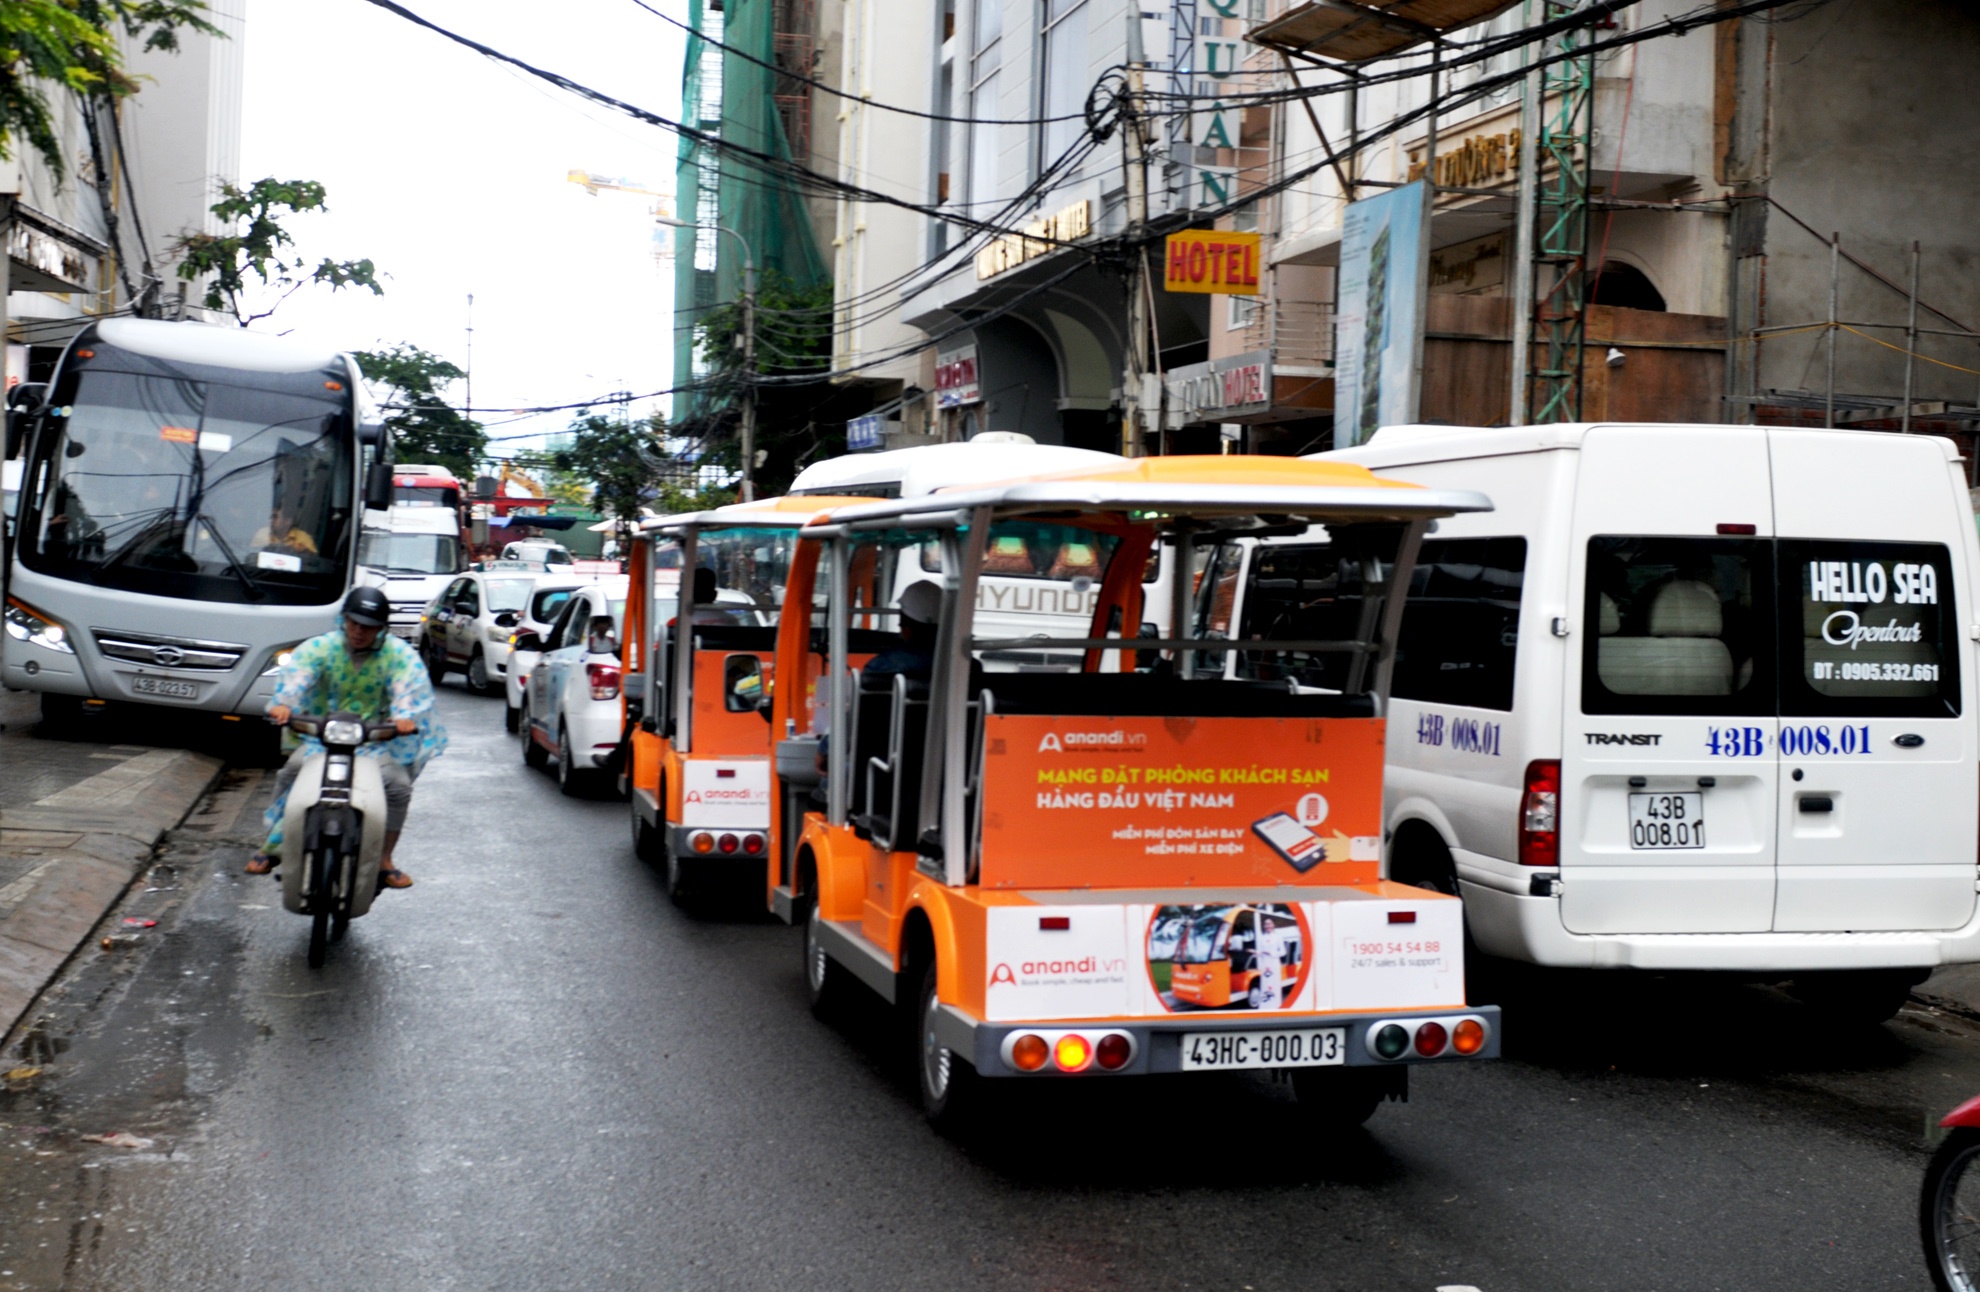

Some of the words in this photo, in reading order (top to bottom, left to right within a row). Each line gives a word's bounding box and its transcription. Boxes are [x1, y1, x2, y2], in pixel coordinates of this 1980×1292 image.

[1168, 240, 1258, 286] HOTEL
[1226, 362, 1268, 408] HOTEL
[1810, 561, 1887, 604] HELLO
[1893, 563, 1938, 604] SEA
[1822, 610, 1922, 650] Opentour
[1841, 662, 1939, 681] 0905.332.661
[1417, 711, 1444, 747] 43B
[1452, 716, 1501, 756] 008.01
[1584, 732, 1663, 746] TRANSIT
[1705, 725, 1764, 757] 43B
[1780, 724, 1873, 756] 008.01
[1189, 793, 1235, 808] NAM
[1647, 795, 1686, 819] 43B
[1633, 820, 1704, 847] 008.01
[1352, 942, 1384, 955] 1900
[1387, 942, 1402, 954] 54
[1406, 942, 1421, 953] 54
[1424, 941, 1440, 952] 88
[1351, 958, 1373, 969] 24/7
[1190, 1032, 1339, 1066] 43HC-000.03
